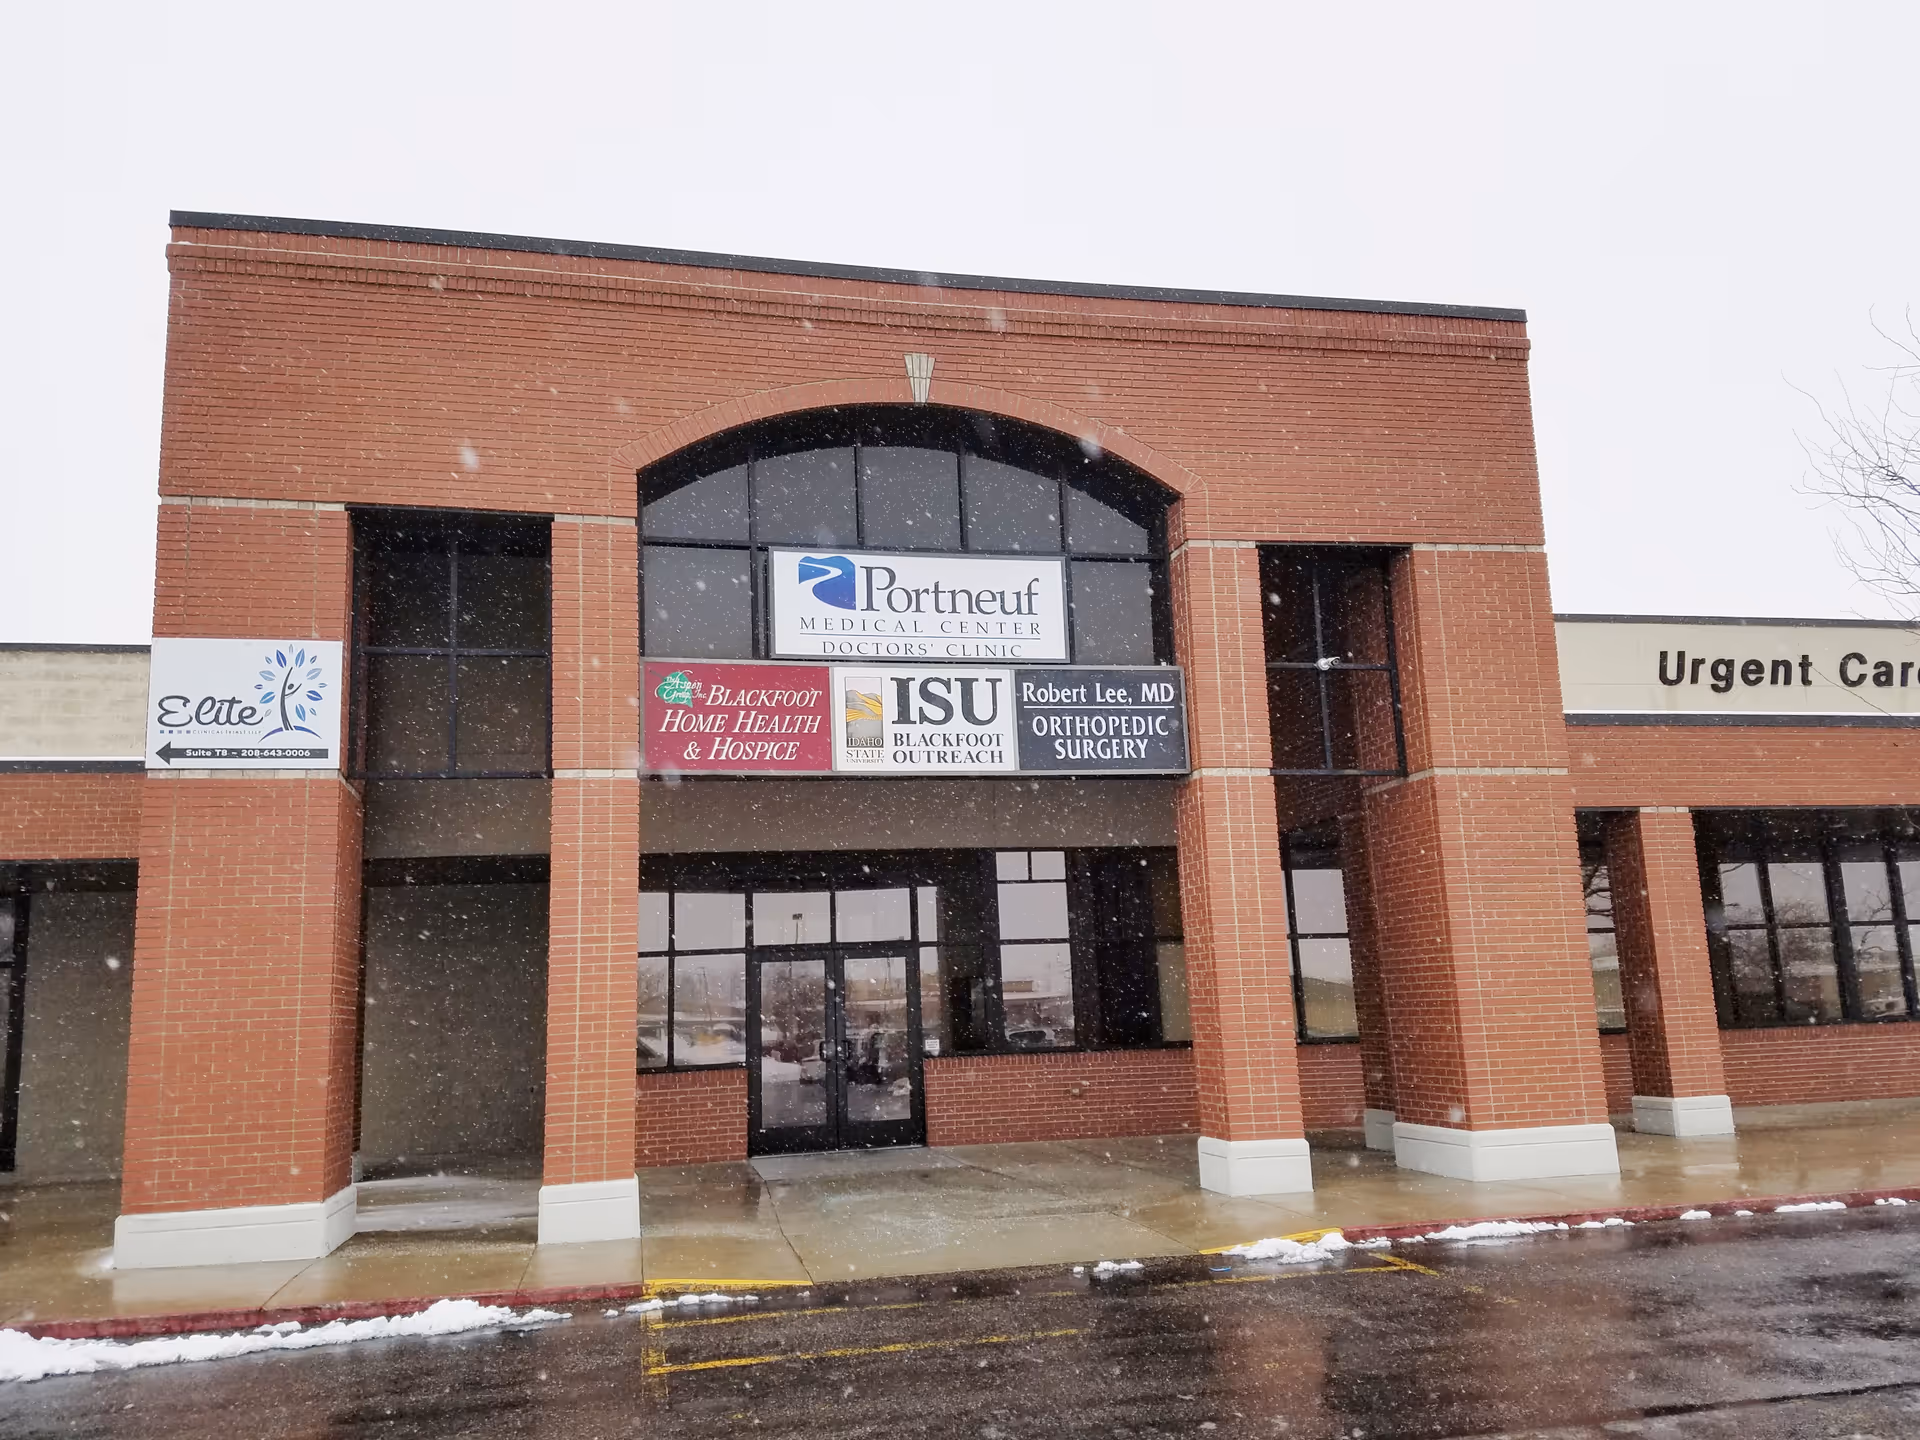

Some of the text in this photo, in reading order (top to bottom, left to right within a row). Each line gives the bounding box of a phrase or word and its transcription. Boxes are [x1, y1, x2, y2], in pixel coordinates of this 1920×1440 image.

[859, 565, 1040, 616] Portneuf
[800, 616, 1041, 635] MEDICAL CENTER
[822, 640, 1022, 658] DOCTORS' CLINIC
[1658, 650, 1920, 694] Urgent Car
[705, 684, 823, 708] BLACKFOOT
[890, 676, 1003, 726] ISU
[1022, 682, 1175, 706] Robert Lee, MD
[157, 695, 264, 728] Elite
[658, 709, 823, 734] HOME HEALTH
[1032, 715, 1169, 737] ORTHOPEDIC
[683, 737, 801, 761] & HOSPICE
[847, 737, 884, 747] IDAHO
[893, 732, 1004, 747] BLACKFOOT
[1054, 738, 1149, 760] SURGERY
[185, 749, 212, 757] Suite
[240, 749, 311, 758] 208-643-0006
[846, 749, 885, 759] STATE
[892, 750, 1004, 764] OUTREACH
